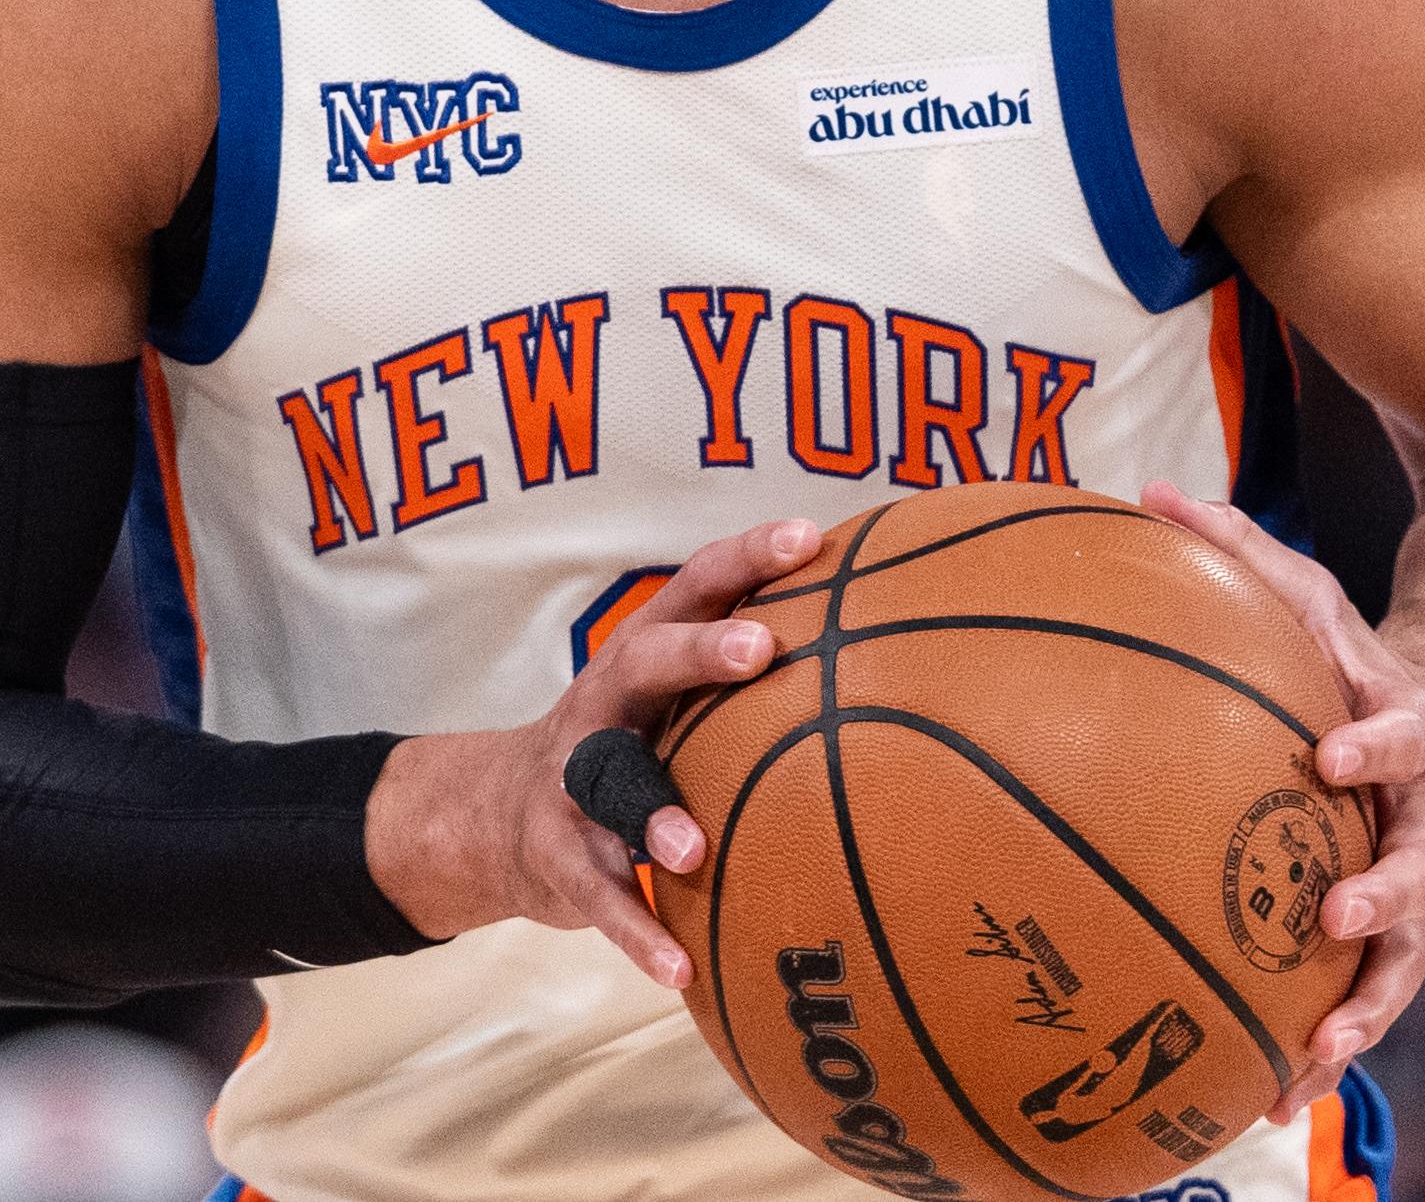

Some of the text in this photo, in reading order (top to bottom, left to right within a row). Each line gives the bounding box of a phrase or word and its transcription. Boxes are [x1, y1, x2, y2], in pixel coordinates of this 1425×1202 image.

[320, 71, 522, 184] NYC
[808, 104, 895, 143] abu
[277, 285, 1096, 556] NEW YORK
[777, 940, 966, 1202] ilson
